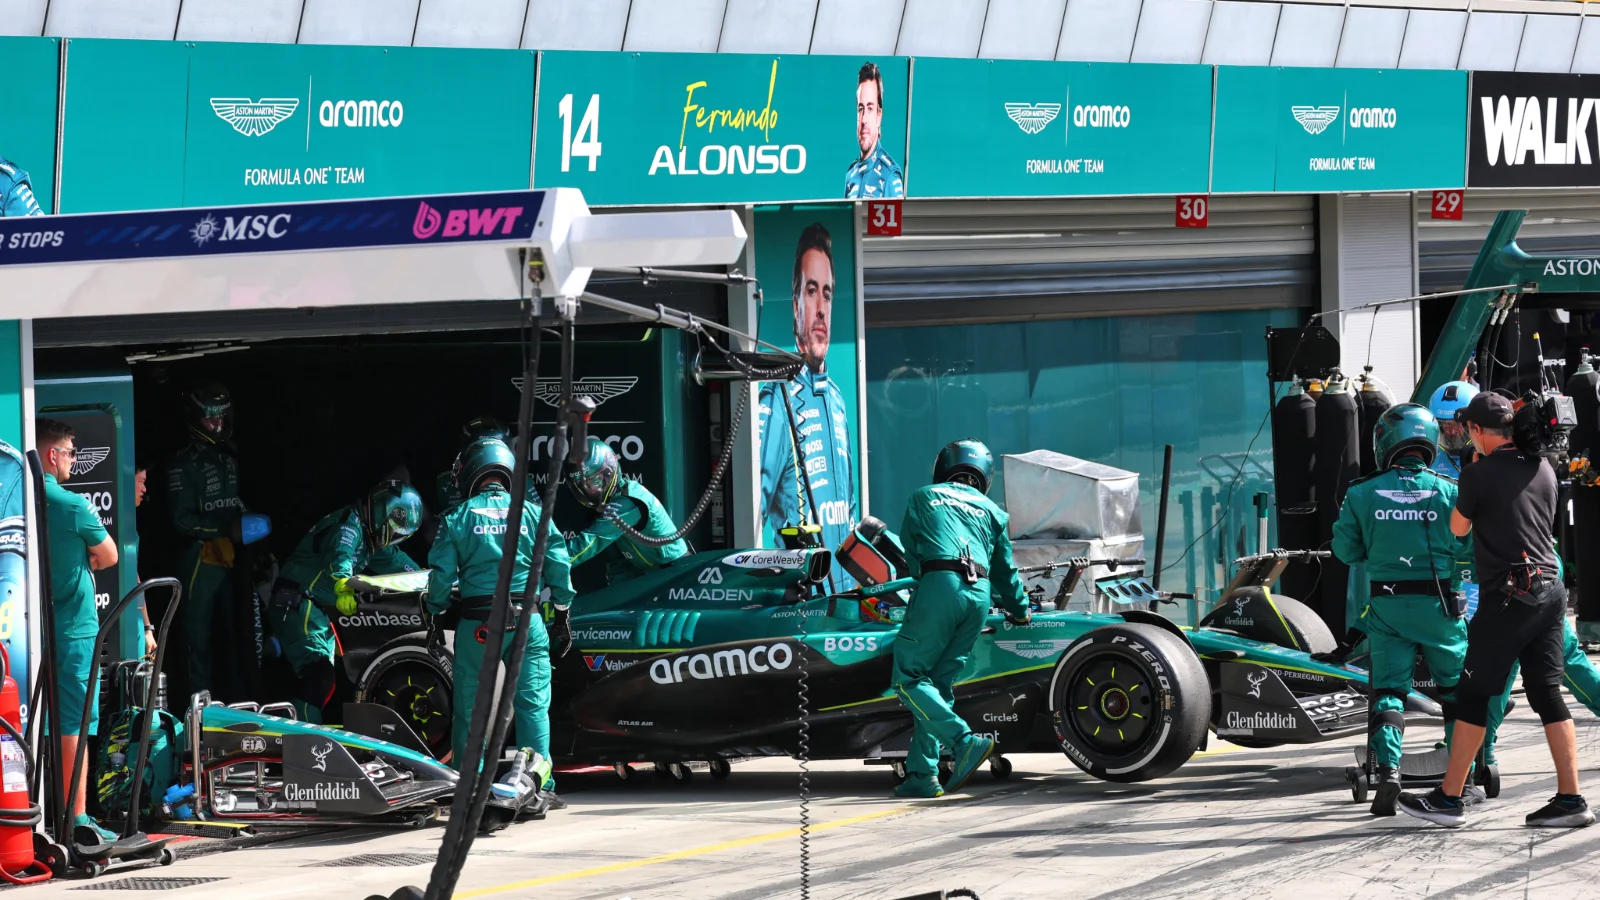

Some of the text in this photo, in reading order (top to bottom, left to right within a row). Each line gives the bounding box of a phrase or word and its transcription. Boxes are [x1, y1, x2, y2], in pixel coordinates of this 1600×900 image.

[236, 106, 274, 115] ASTON MARTIN
[319, 100, 404, 128] aramco
[679, 60, 779, 149] Fernando
[1073, 104, 1131, 128] aramco
[1350, 107, 1397, 128] aramco
[558, 94, 602, 172] 14
[648, 144, 807, 176] ALONSO
[1026, 159, 1063, 174] FORMULA
[1083, 159, 1104, 173] TEAM
[1309, 157, 1341, 170] FORMULA
[1357, 157, 1376, 170] TEAM
[244, 168, 300, 186] FORMULA
[334, 167, 365, 184] TEAM
[1180, 198, 1206, 220] 30
[1435, 191, 1461, 212] 29
[441, 206, 524, 238] BWT
[872, 203, 898, 227] 31
[218, 213, 292, 241] MSC
[8, 230, 65, 249] STOPS
[548, 384, 602, 393] AST MARTIN
[1374, 508, 1438, 522] aramco
[1567, 498, 1575, 526] 1
[751, 555, 803, 565] CoreWeave
[668, 588, 754, 602] MAADEN
[869, 584, 885, 594] citi
[338, 611, 422, 627] coinbase
[771, 610, 797, 619] ASTON
[1224, 617, 1254, 626] Glenfiddich
[571, 627, 632, 640] ervicenow
[824, 636, 878, 652] BOSS
[649, 642, 793, 685] aramco
[1111, 635, 1171, 690] P ZERO
[1226, 711, 1297, 729] Glenfiddich
[1061, 738, 1095, 771] PIRELLI
[284, 781, 360, 801] Glenfiddich
